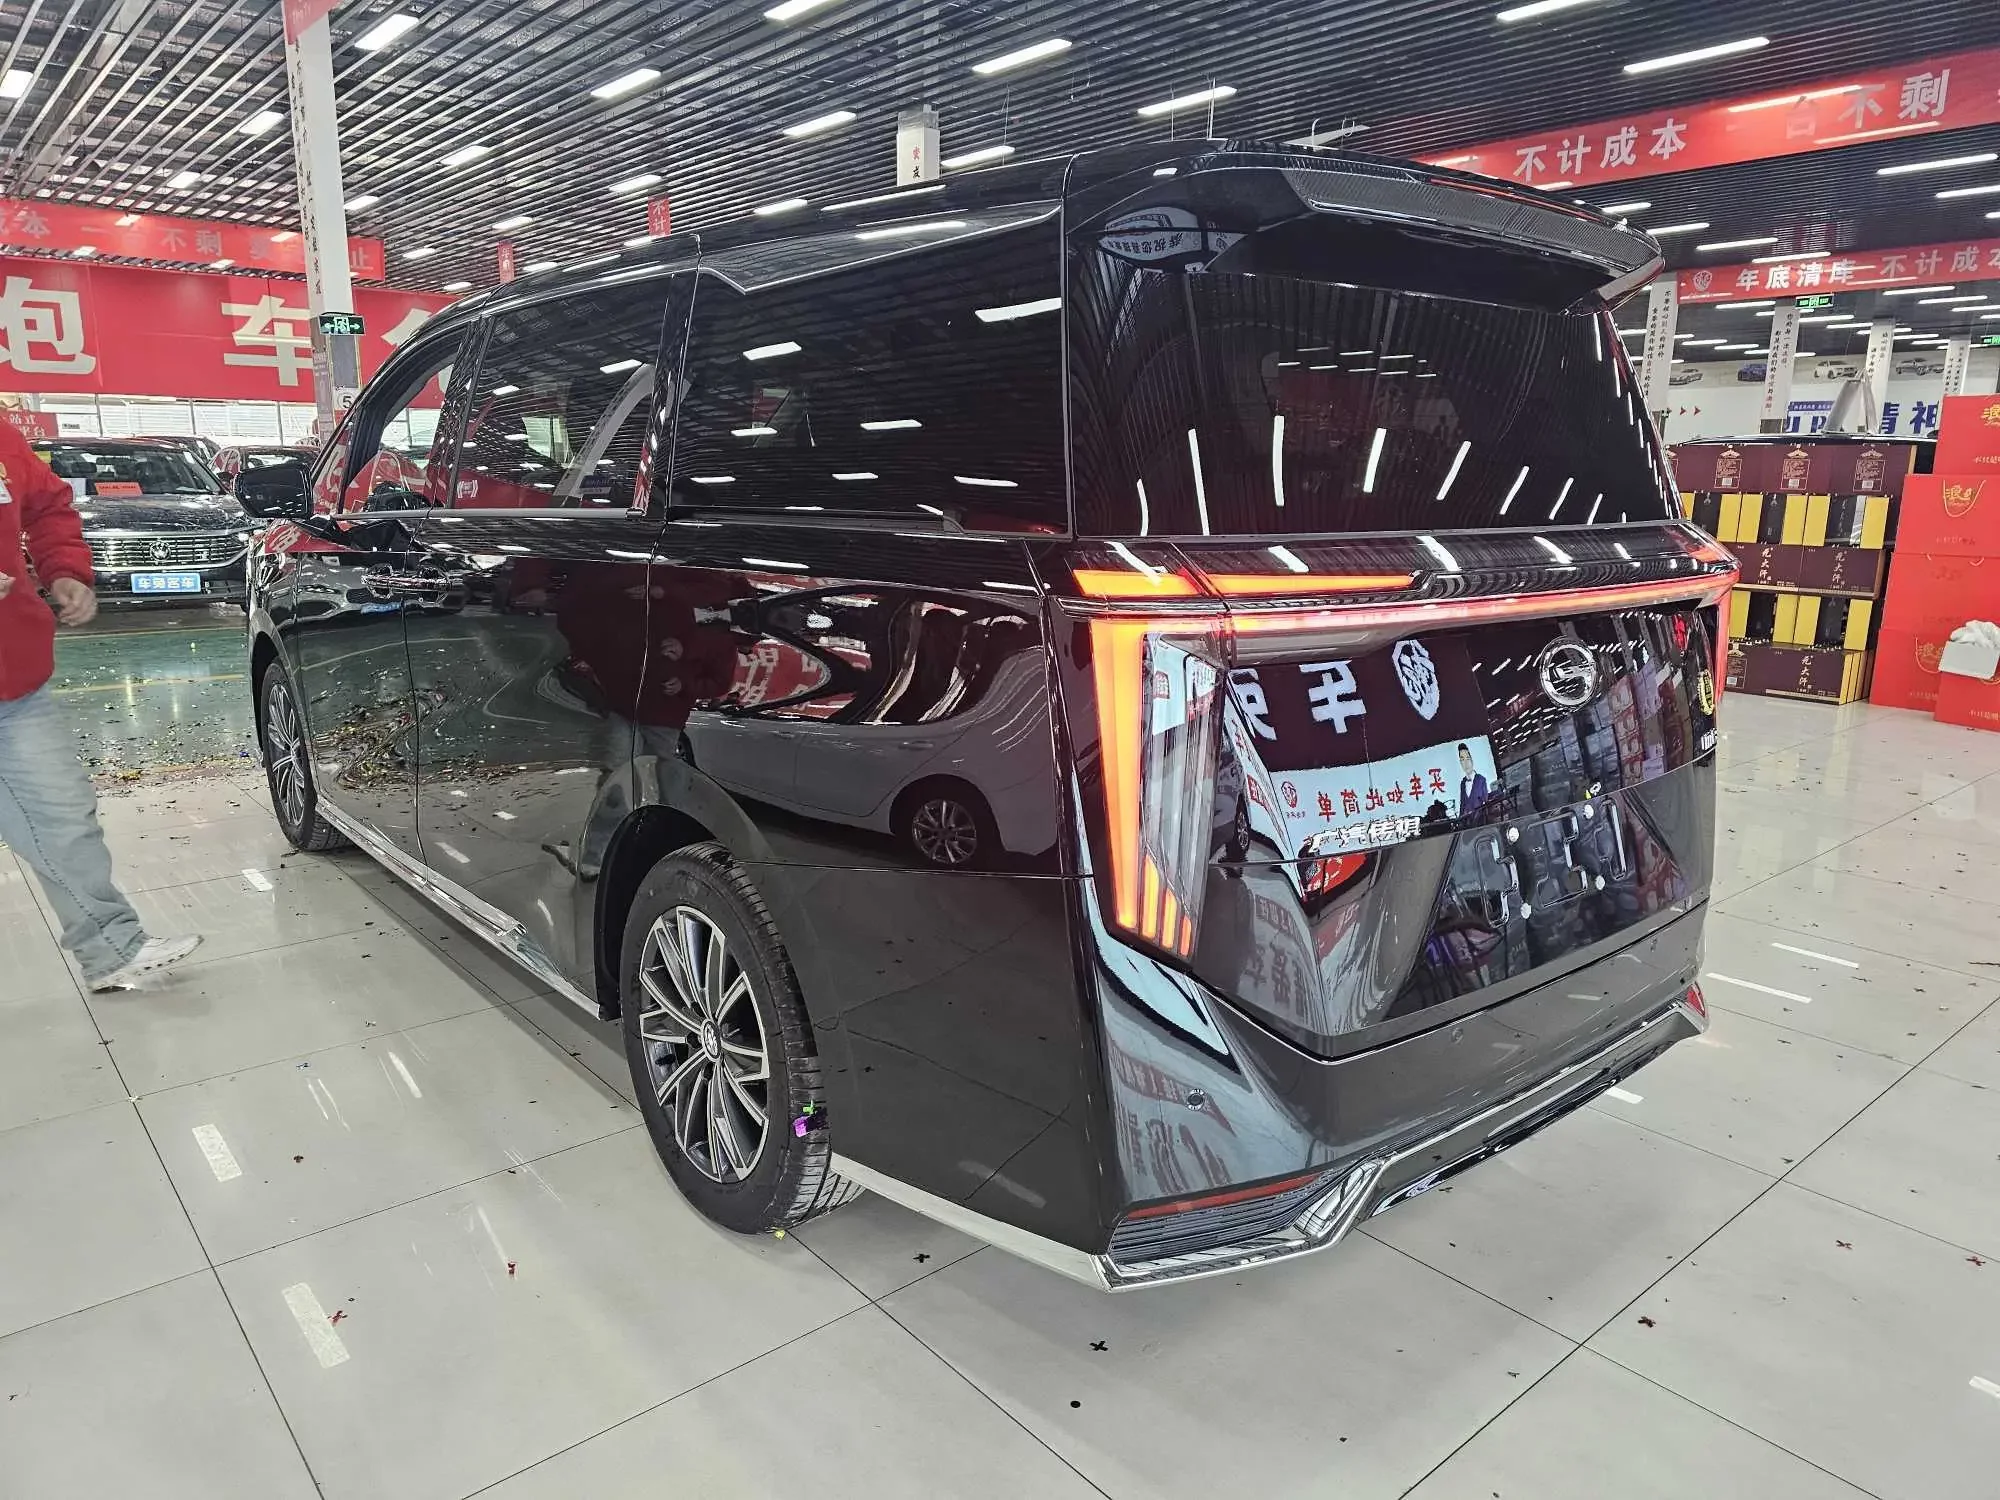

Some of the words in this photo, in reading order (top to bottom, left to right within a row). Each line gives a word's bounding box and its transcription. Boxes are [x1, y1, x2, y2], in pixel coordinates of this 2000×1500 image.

[1513, 118, 1687, 183] 不计成本
[1736, 261, 1855, 292] 年底清库
[343, 395, 352, 408] 5
